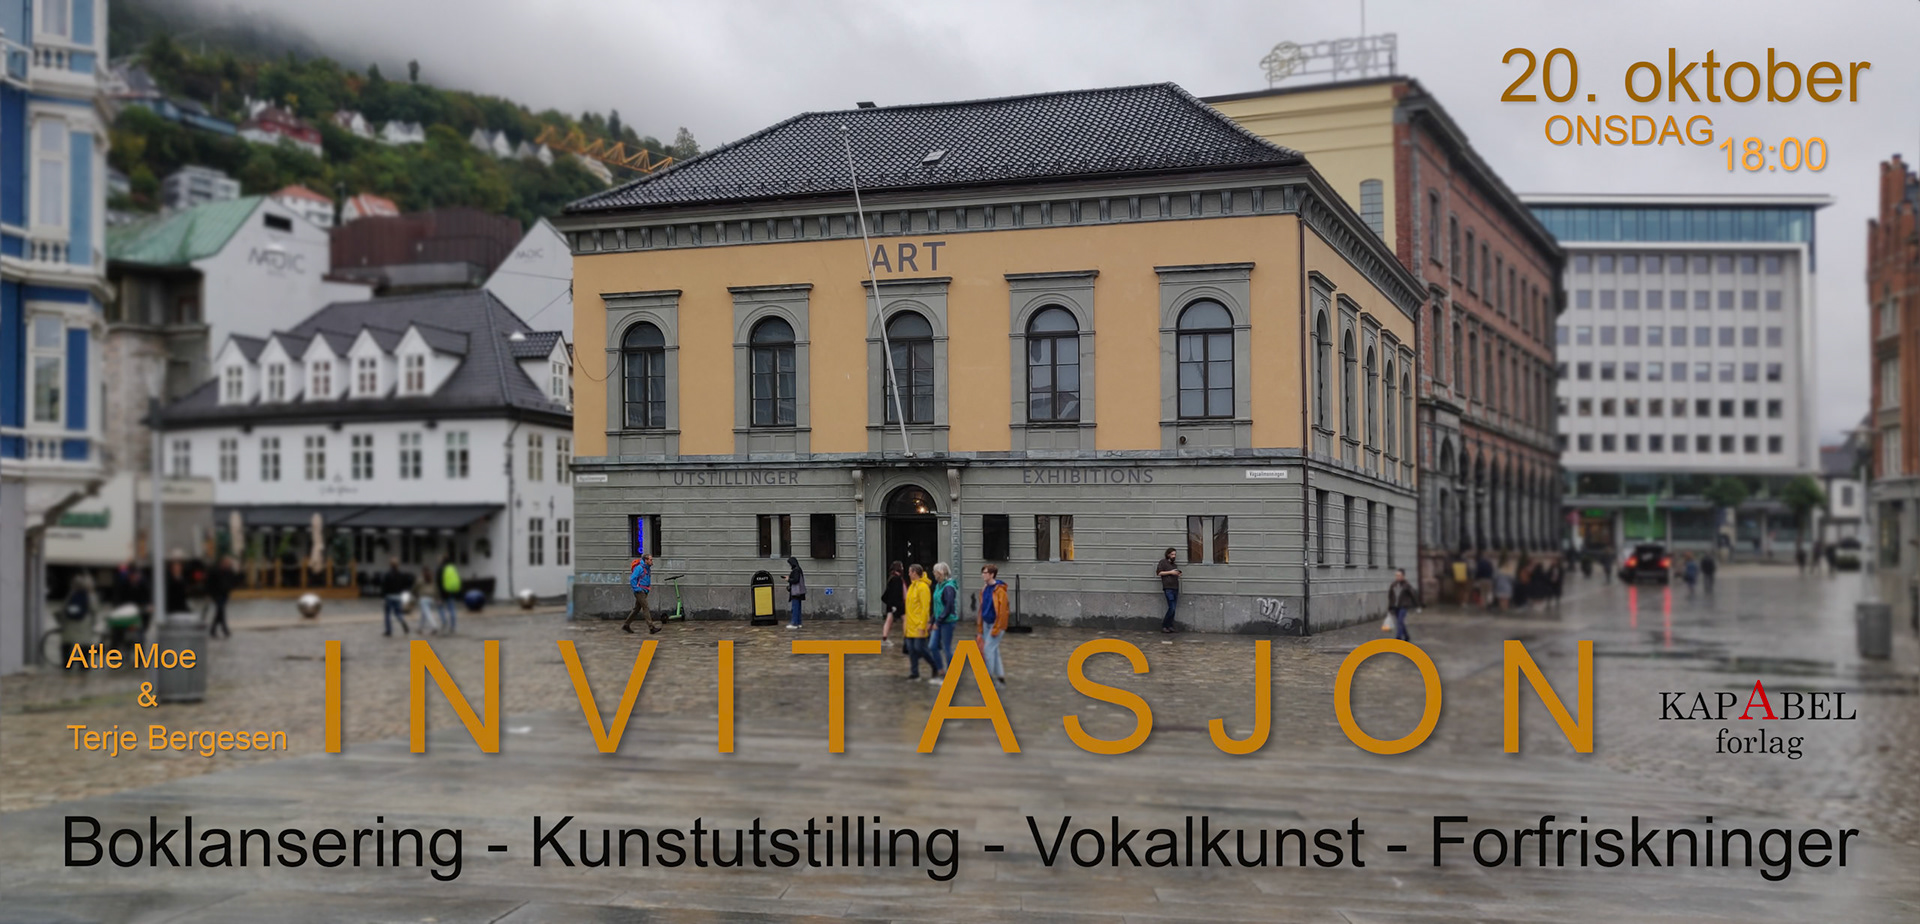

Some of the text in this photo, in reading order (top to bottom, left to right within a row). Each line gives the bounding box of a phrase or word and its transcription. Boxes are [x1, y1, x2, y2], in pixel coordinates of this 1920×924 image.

[868, 241, 946, 273] ART
[674, 469, 799, 486] UTSTILLINGER
[1023, 468, 1154, 484] EXHIBITIONS
